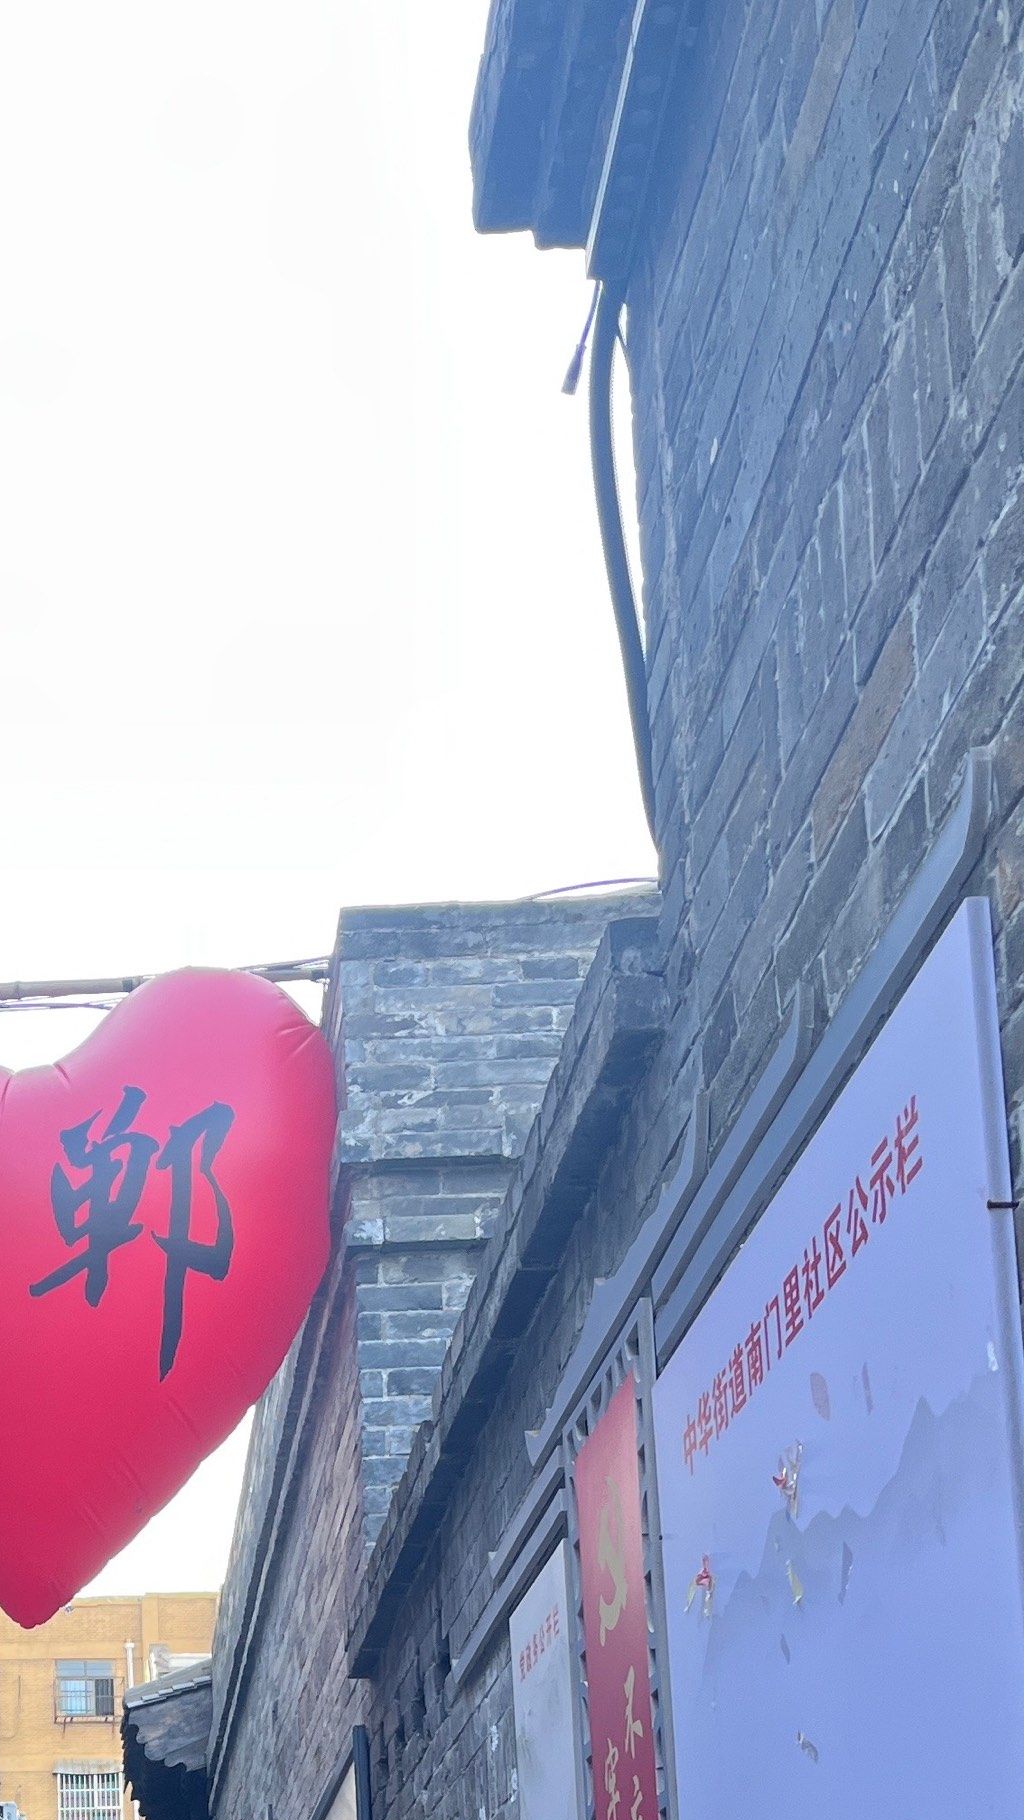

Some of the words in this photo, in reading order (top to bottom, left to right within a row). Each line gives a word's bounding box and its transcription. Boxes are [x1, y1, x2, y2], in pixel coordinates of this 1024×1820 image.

[683, 1095, 923, 1476] 中华街道南门里社区公示栏
